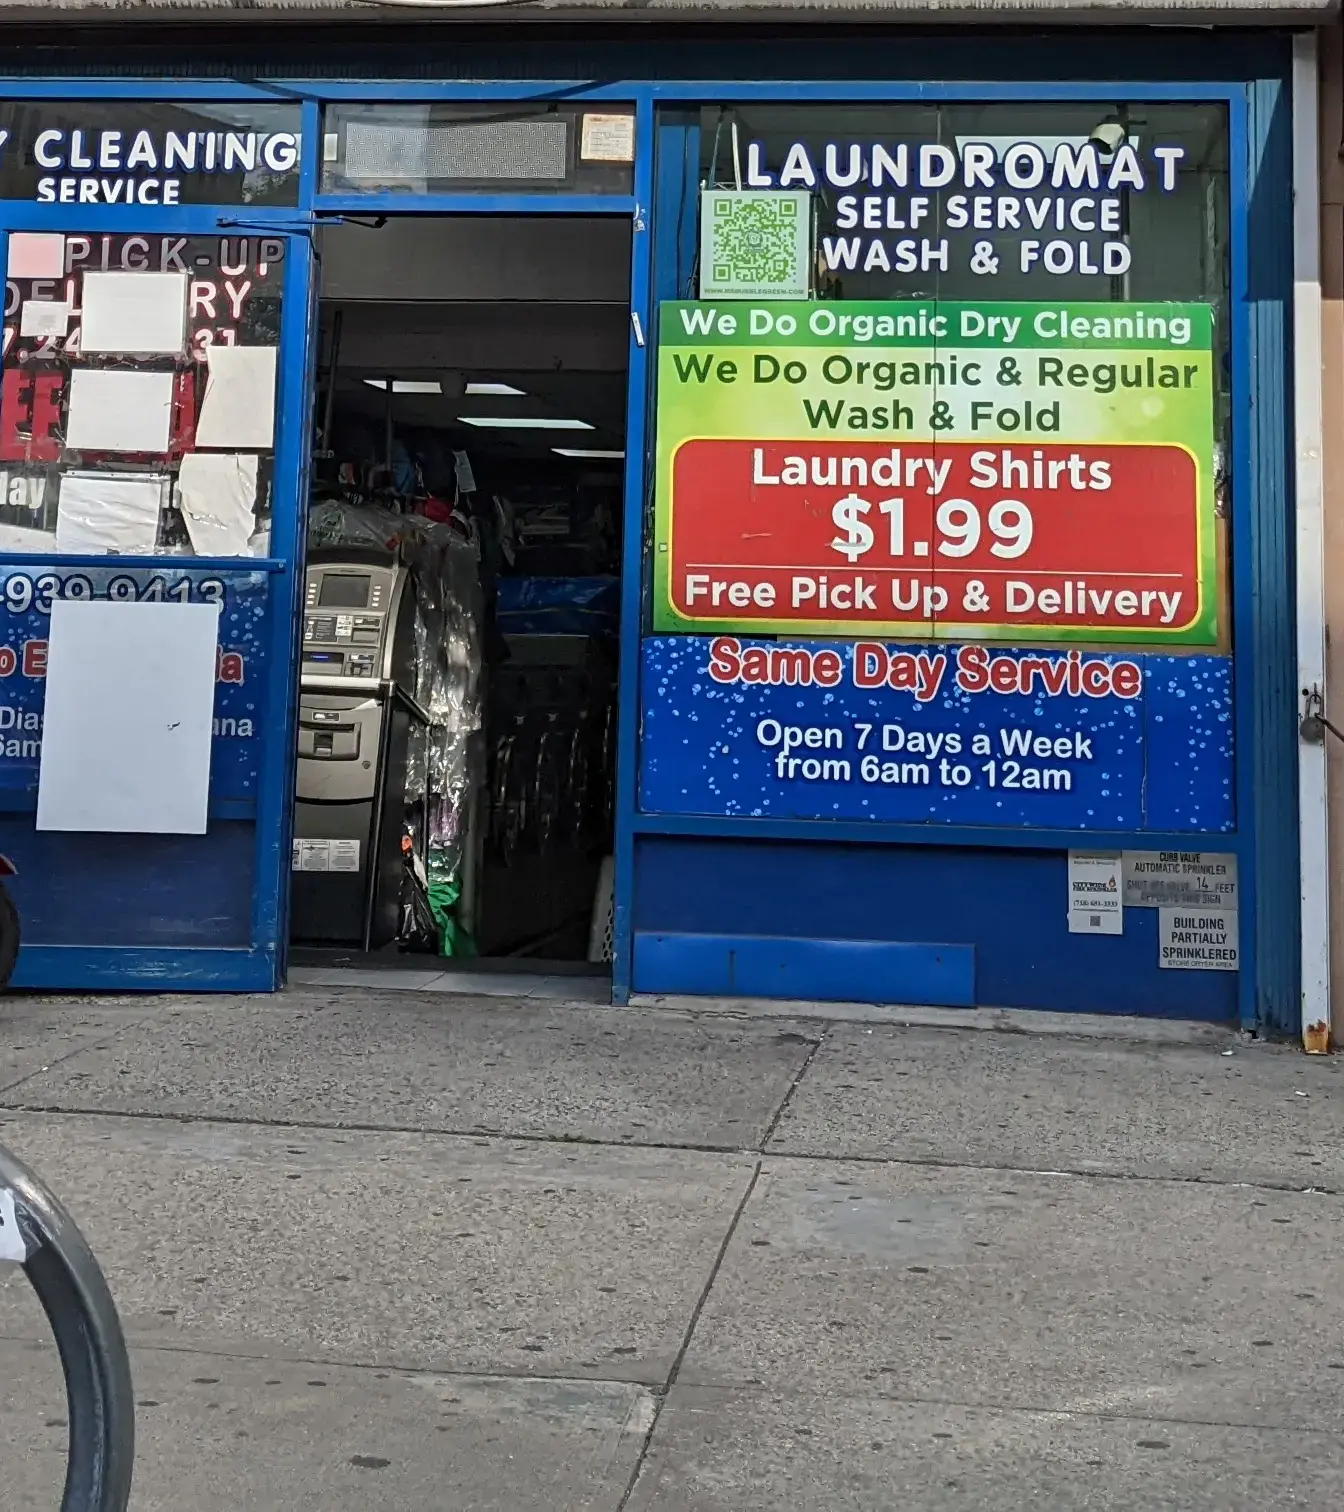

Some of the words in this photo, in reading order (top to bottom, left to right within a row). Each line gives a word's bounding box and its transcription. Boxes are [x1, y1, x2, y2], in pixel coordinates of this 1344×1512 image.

[34, 129, 298, 171] CLEANING
[747, 142, 1185, 190] LAUNDROMAT
[37, 179, 180, 205] SERVICE
[836, 196, 928, 229] SELF
[946, 196, 1121, 233] SERVICE
[66, 237, 287, 275] PICK-UP
[822, 237, 949, 273] WASH
[970, 241, 1000, 275] &
[1020, 240, 1132, 276] FOLD
[679, 310, 737, 336] We
[749, 311, 797, 336] Do
[808, 310, 948, 341] Organic
[960, 312, 1022, 343] Dry
[1033, 311, 1192, 343] Cleaning
[672, 353, 739, 385] We
[753, 355, 808, 385] Do
[822, 354, 982, 392] Organic
[995, 357, 1023, 387] &
[1037, 358, 1199, 397] Regular
[803, 399, 914, 430] Wash
[928, 401, 955, 431] &
[971, 400, 1062, 433] Fold
[753, 449, 953, 495] Laundry
[969, 450, 1113, 491] Shirts
[830, 493, 1034, 563] $1.99
[685, 575, 776, 608] Free
[792, 577, 877, 611] Pick
[891, 581, 949, 617] Up
[962, 582, 990, 613] &
[1005, 580, 1184, 624] Delivery
[708, 635, 844, 688] Same
[853, 642, 946, 703] Day
[956, 644, 1143, 699] Service
[755, 719, 843, 757] Open
[855, 724, 869, 751] 7
[881, 724, 962, 760] Days
[971, 734, 991, 756] a
[1001, 728, 1093, 760] Week
[775, 751, 852, 782] from
[861, 756, 930, 785] 6am
[939, 758, 971, 787] to
[982, 760, 1072, 791] 12am
[1134, 862, 1180, 874] AUTOMATIC
[1182, 864, 1227, 875] SPRINKLER
[1159, 852, 1178, 862] CURB
[1180, 852, 1201, 864] VALVE
[1196, 876, 1209, 890] 14
[1215, 883, 1235, 894] FEET
[1171, 932, 1227, 945] PARTIALLY
[1173, 917, 1225, 930] BUILDING
[1162, 947, 1237, 961] SPRINKLERED
